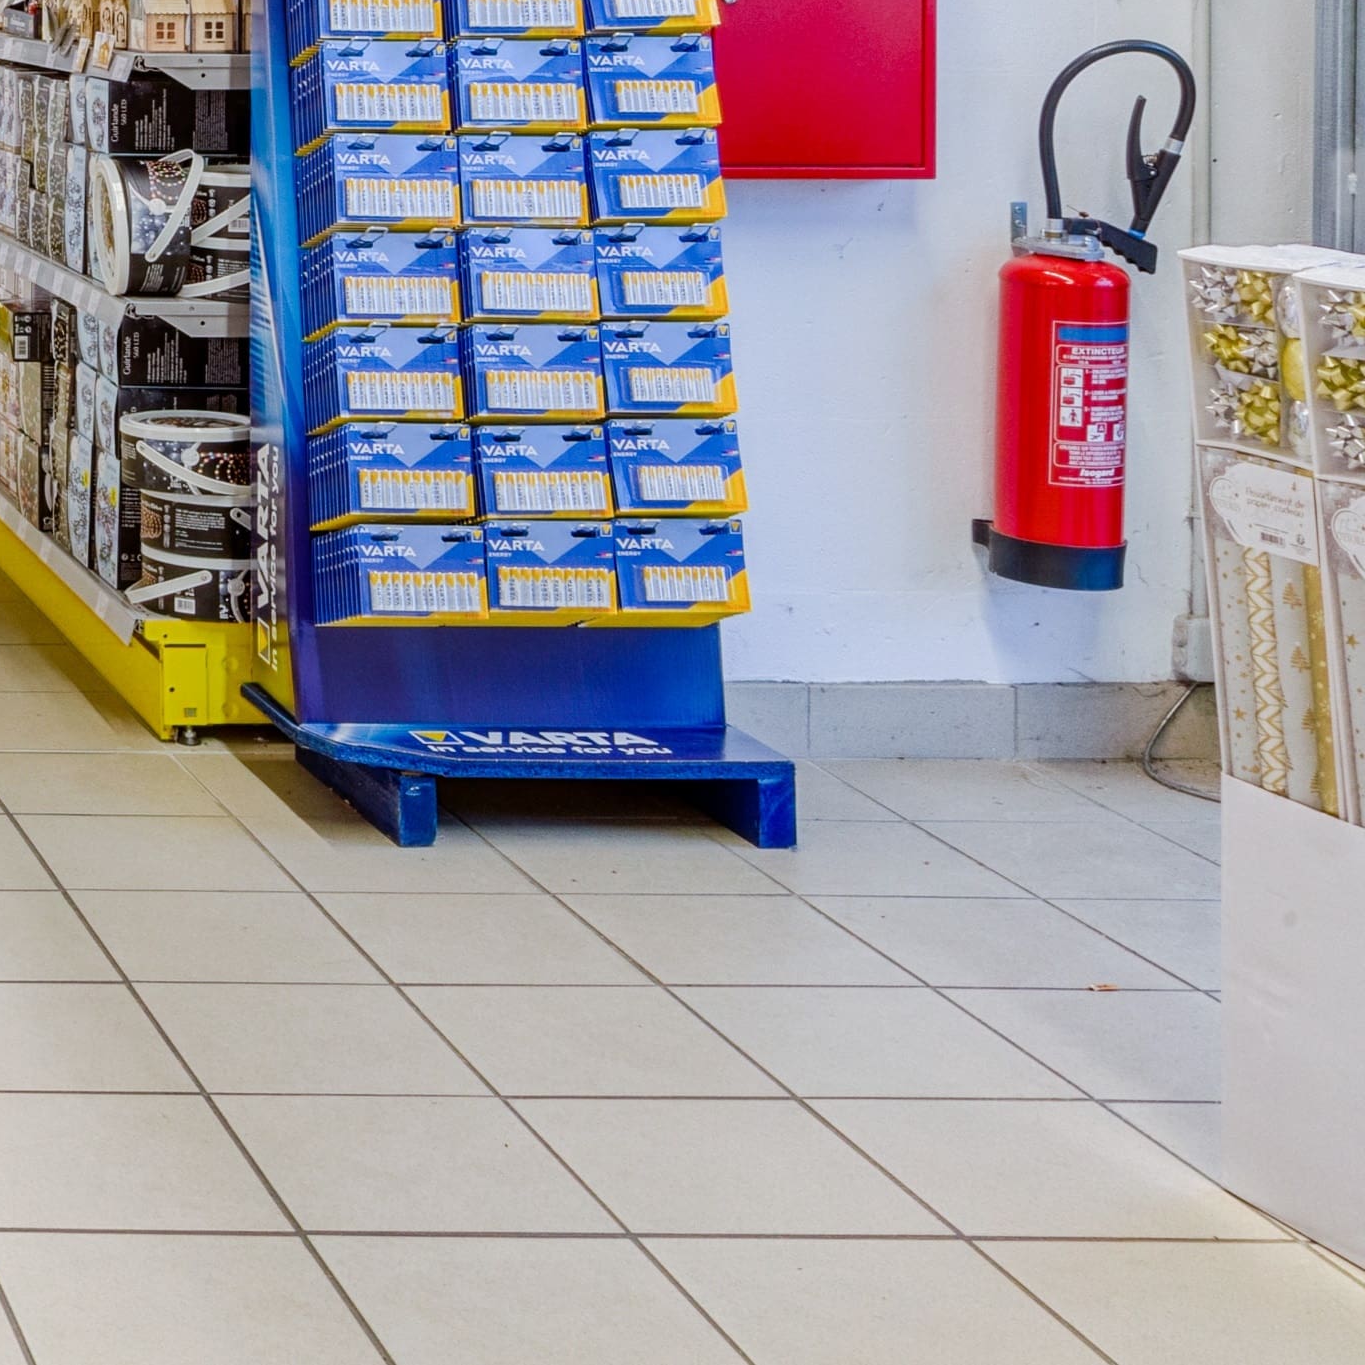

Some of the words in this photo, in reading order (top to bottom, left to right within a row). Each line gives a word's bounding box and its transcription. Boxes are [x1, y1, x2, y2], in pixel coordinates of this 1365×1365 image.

[327, 60, 380, 72] VARTA
[460, 58, 514, 69] VARTA
[590, 55, 645, 66] VARTA
[110, 103, 119, 143] Guirlande
[337, 153, 391, 165] VARTA
[462, 154, 516, 165] VARTA
[594, 149, 650, 160] VARTA
[335, 251, 389, 262] VARTA
[471, 247, 526, 258] VARTA
[598, 246, 653, 256] VARTA
[338, 346, 391, 357] VARTA
[477, 345, 532, 356] VARTA
[604, 342, 661, 352] VARTA
[122, 335, 131, 376] Guirlande
[350, 443, 404, 454] VARTA
[613, 439, 670, 450] VARTA
[483, 445, 537, 456] VARTA
[269, 446, 279, 494] you
[269, 498, 278, 536] for
[257, 443, 270, 609] VARTA
[489, 540, 544, 551] VARTA
[619, 539, 673, 549] VARTA
[361, 545, 416, 557] VARTA
[269, 544, 277, 640] service
[459, 731, 659, 746] VARTA
[462, 746, 567, 754] service
[571, 746, 613, 754] for
[616, 747, 673, 755] you
